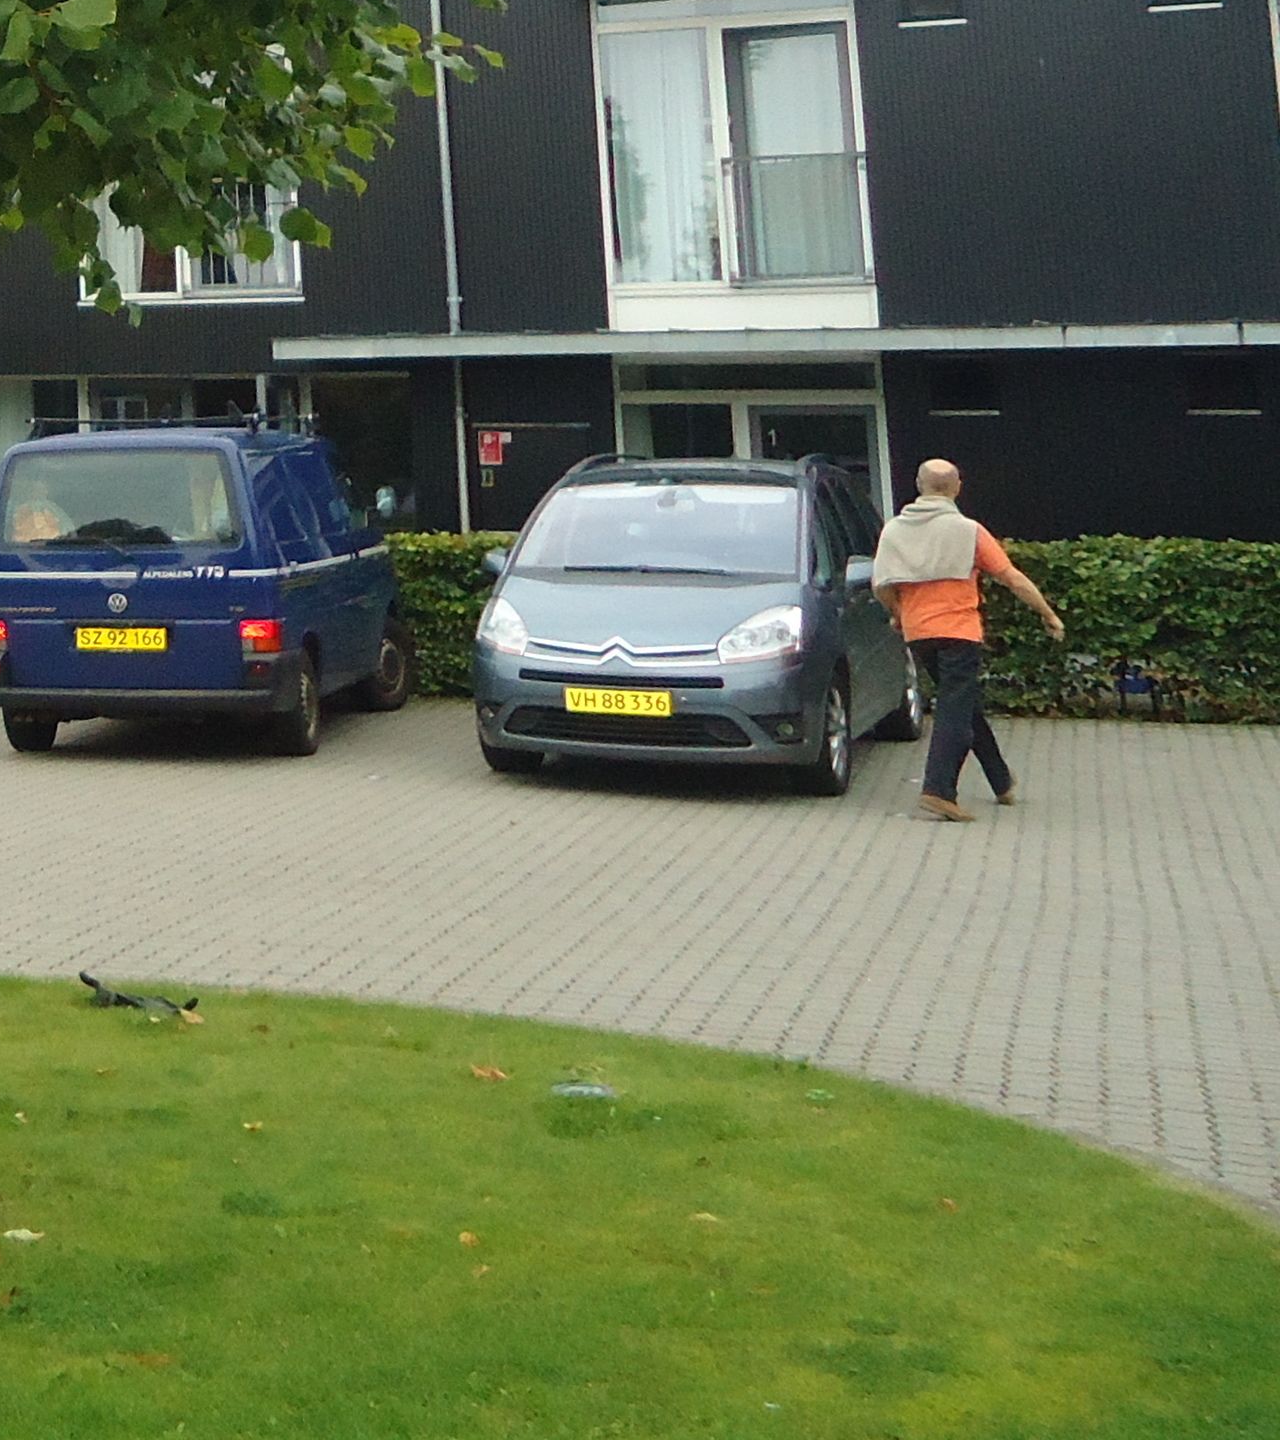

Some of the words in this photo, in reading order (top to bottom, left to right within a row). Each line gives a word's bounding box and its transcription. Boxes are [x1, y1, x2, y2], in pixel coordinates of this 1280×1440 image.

[80, 630, 102, 645] SZ
[107, 630, 128, 645] 92
[134, 630, 162, 646] 166
[570, 691, 596, 708] VH
[601, 692, 626, 710] 88
[630, 694, 667, 712] 336
